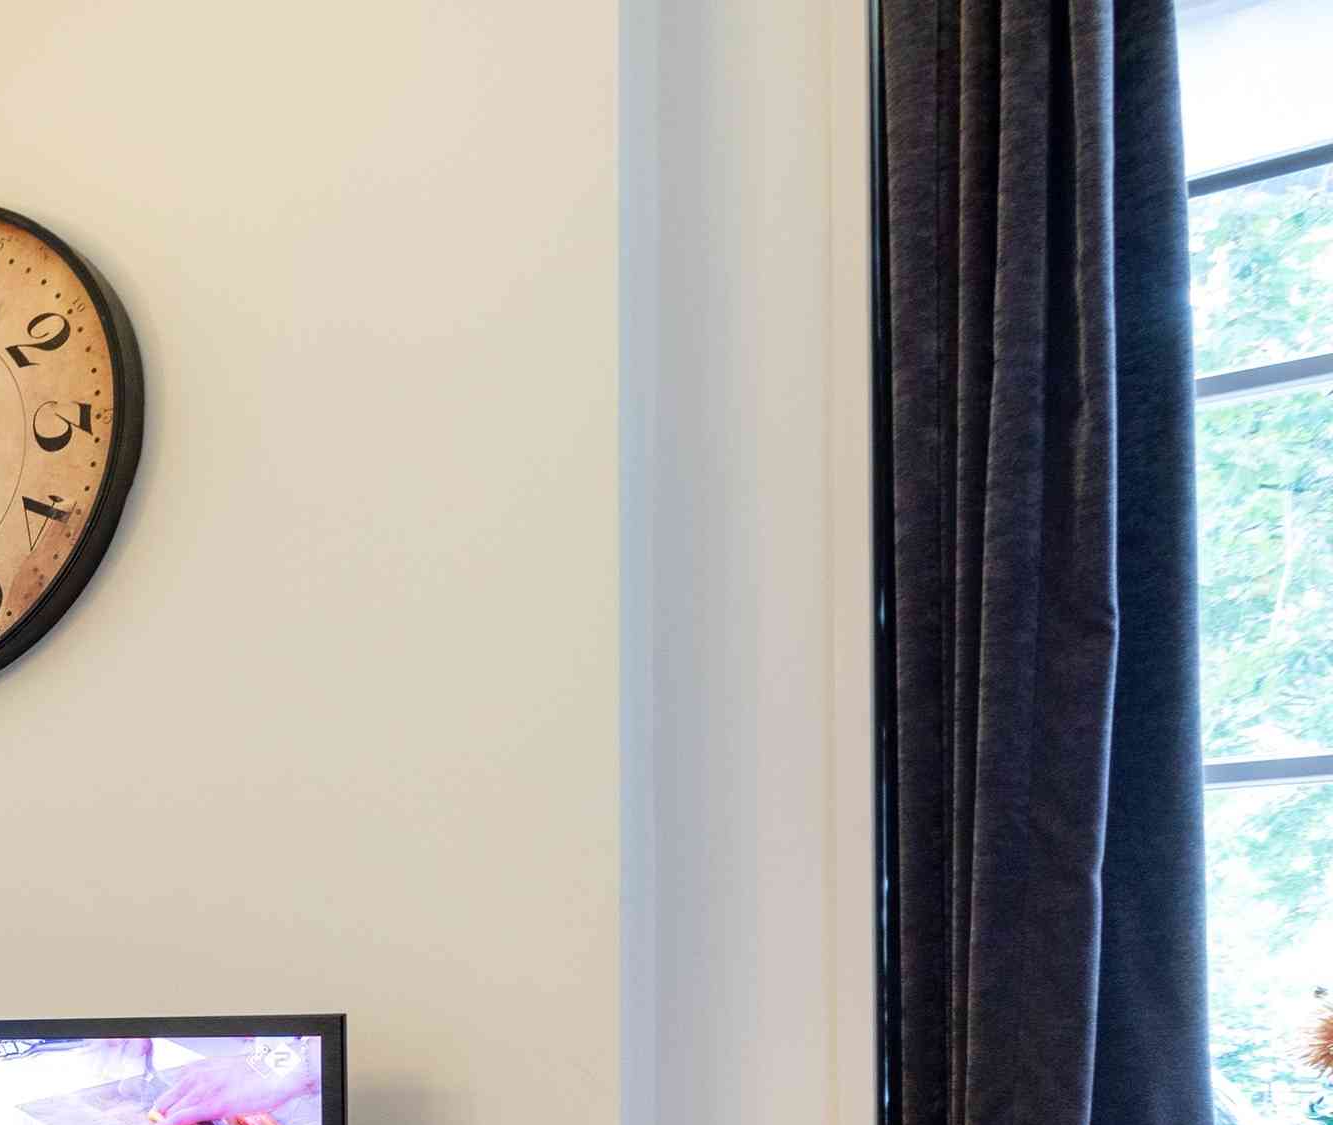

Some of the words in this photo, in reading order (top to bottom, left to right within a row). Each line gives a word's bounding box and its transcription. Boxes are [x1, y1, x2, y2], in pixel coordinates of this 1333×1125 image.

[72, 297, 86, 313] 10
[5, 312, 71, 368] 2
[33, 400, 93, 452] 3
[22, 495, 78, 551] 4
